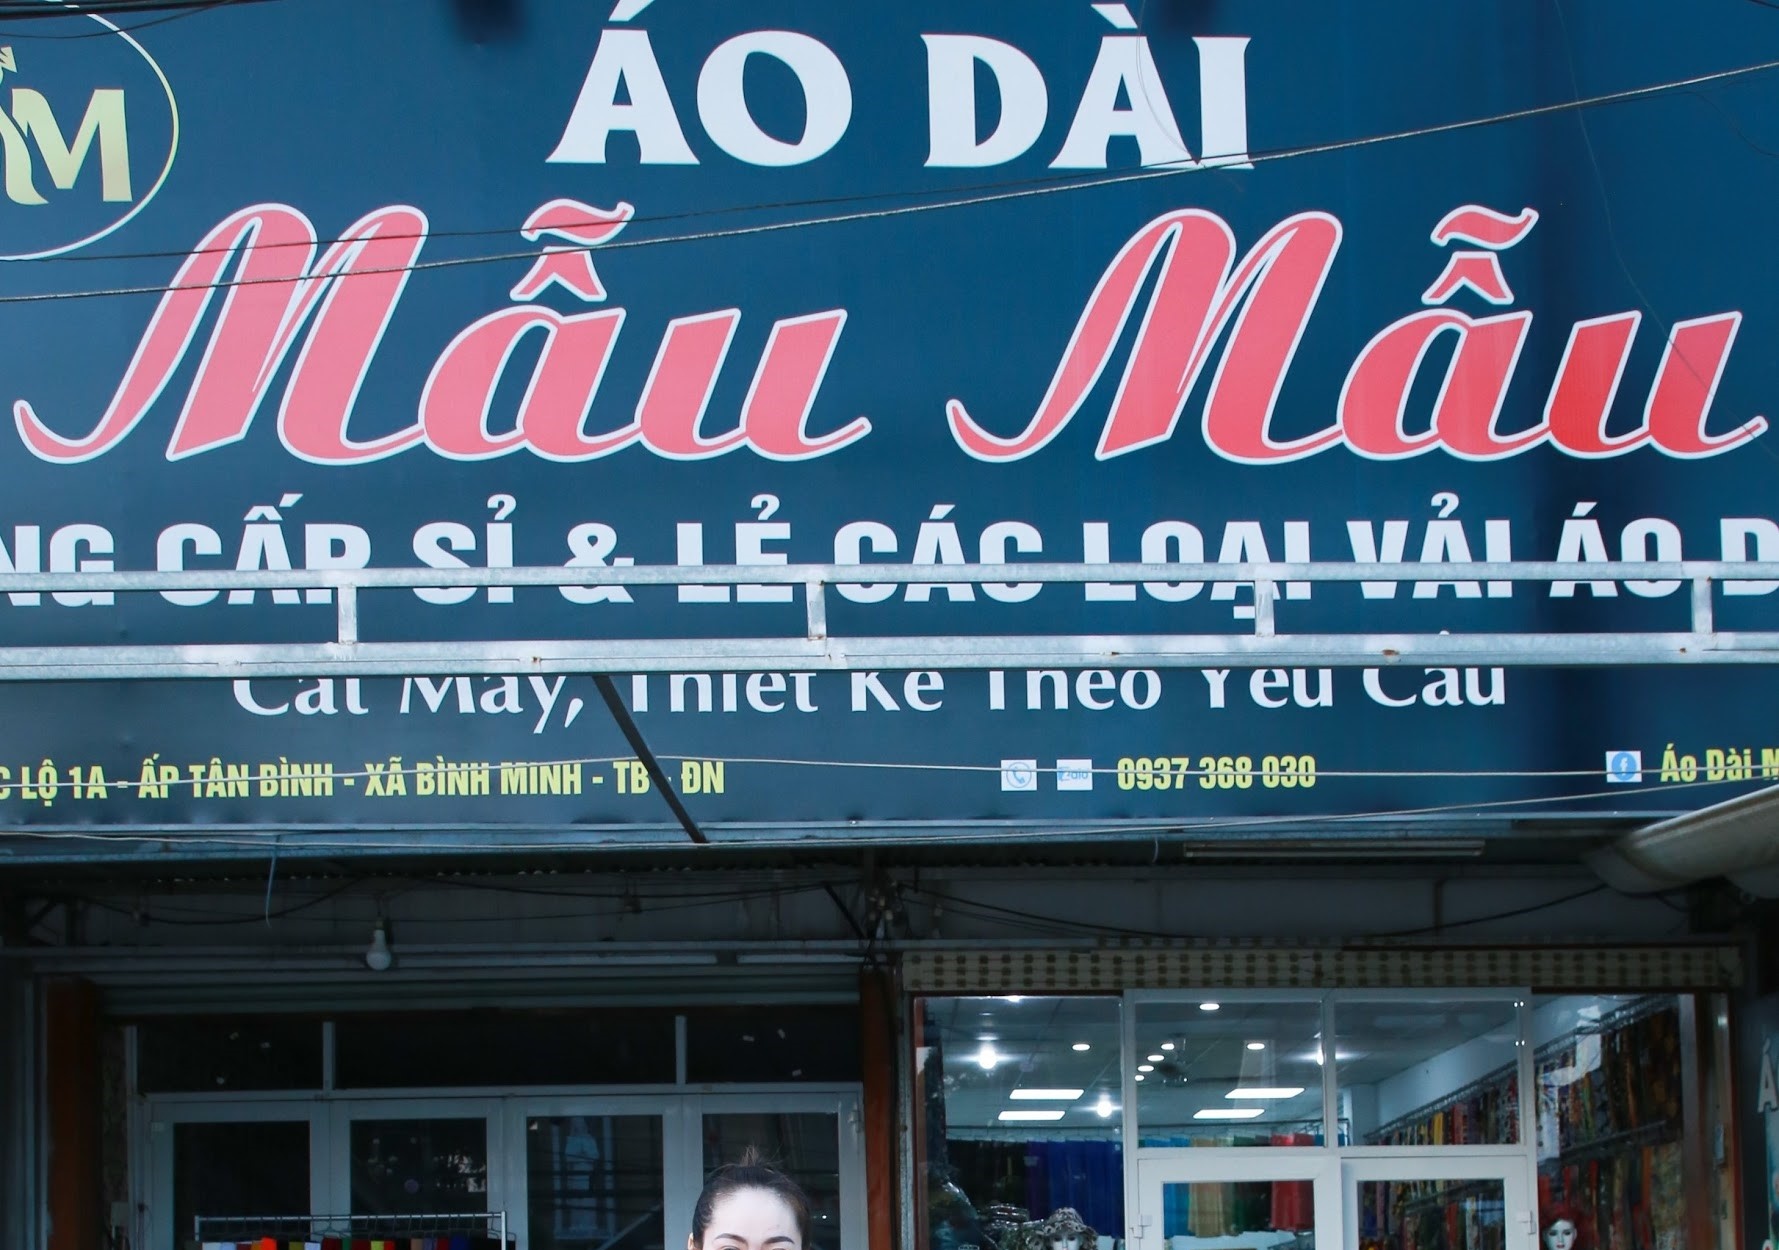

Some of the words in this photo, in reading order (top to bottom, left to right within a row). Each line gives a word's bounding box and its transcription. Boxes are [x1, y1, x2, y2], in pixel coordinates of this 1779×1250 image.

[545, 0, 853, 167] ÁO
[921, 4, 1255, 170] DÀI
[14, 200, 873, 466] Mẫu
[945, 205, 1769, 465] Mẫu
[156, 493, 372, 606] CẤP
[412, 494, 517, 604] SỈ
[558, 522, 635, 604] &
[676, 494, 794, 603] LẺ
[833, 504, 1044, 602] CÁC
[1083, 520, 1312, 619] LOẠI
[1346, 492, 1513, 599] VẢI
[1549, 501, 1684, 598] ÁO
[21, 759, 58, 806] LỘ
[69, 766, 108, 799] 1A
[138, 753, 181, 798] ẤP
[189, 757, 249, 797] TÂN
[259, 756, 333, 796] BÌNH
[365, 756, 408, 796] XÃ
[416, 755, 490, 796] BÌNH
[500, 761, 582, 795] MINH
[613, 761, 650, 794] TB
[681, 761, 724, 794] ĐN
[1117, 757, 1190, 790] 0937
[1199, 756, 1252, 789] 368
[1261, 755, 1316, 789] 030
[1660, 743, 1697, 783] Áo
[1706, 747, 1753, 782] Dài
[1757, 1038, 1779, 1113] Á
